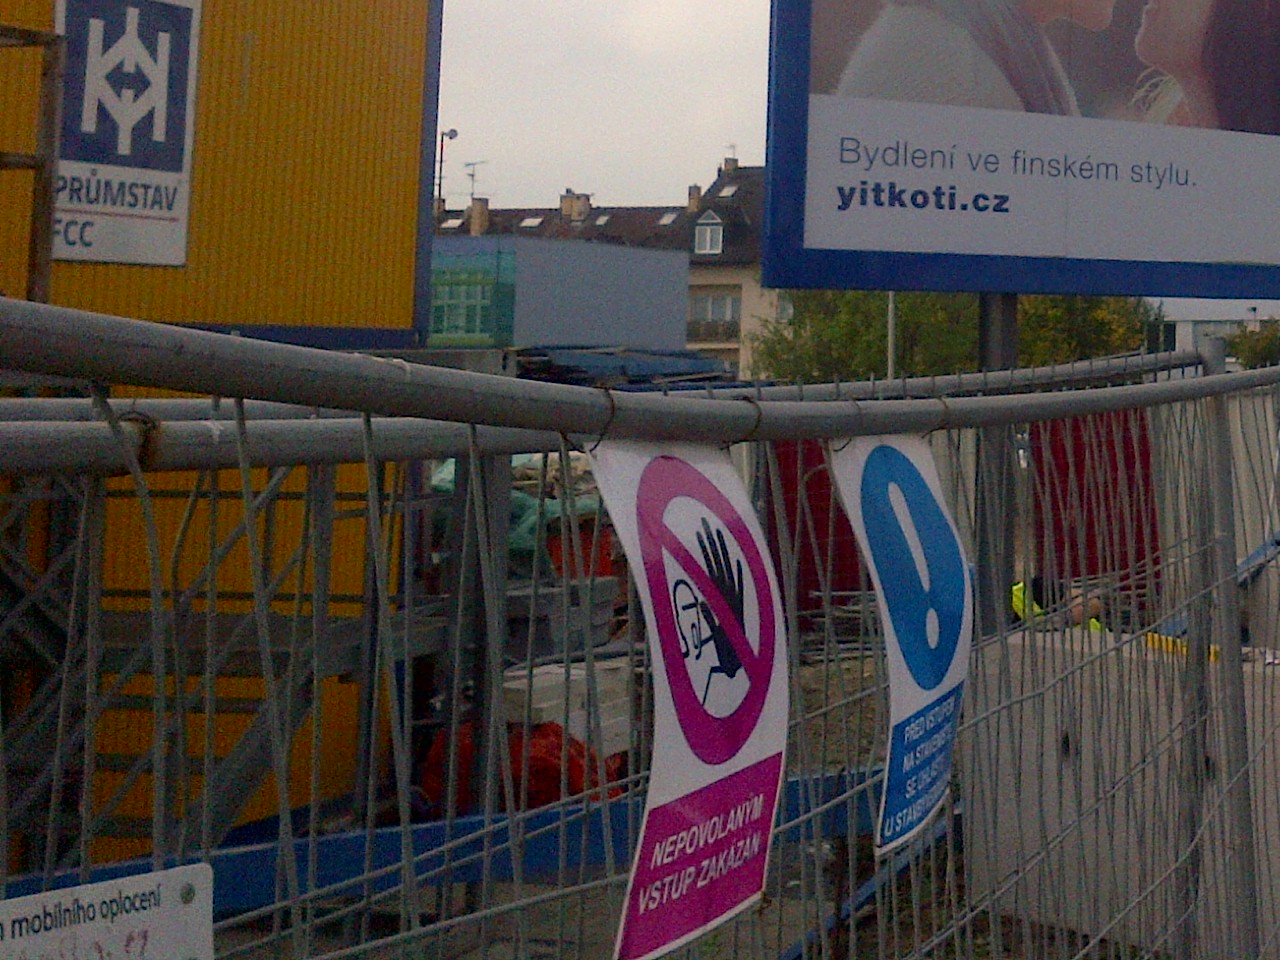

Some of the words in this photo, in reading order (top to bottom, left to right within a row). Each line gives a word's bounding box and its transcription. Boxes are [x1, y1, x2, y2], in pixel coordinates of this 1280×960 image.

[840, 137, 955, 171] Bydlení
[967, 152, 1000, 173] ve
[1011, 149, 1119, 181] finském
[1130, 161, 1198, 189] stylu.
[836, 181, 1010, 213] yitkoti.cz
[650, 792, 764, 871] NEPOVOLANÝM
[11, 898, 97, 939] mobilního
[100, 883, 162, 924] oplocení
[639, 866, 696, 915] VSTUP
